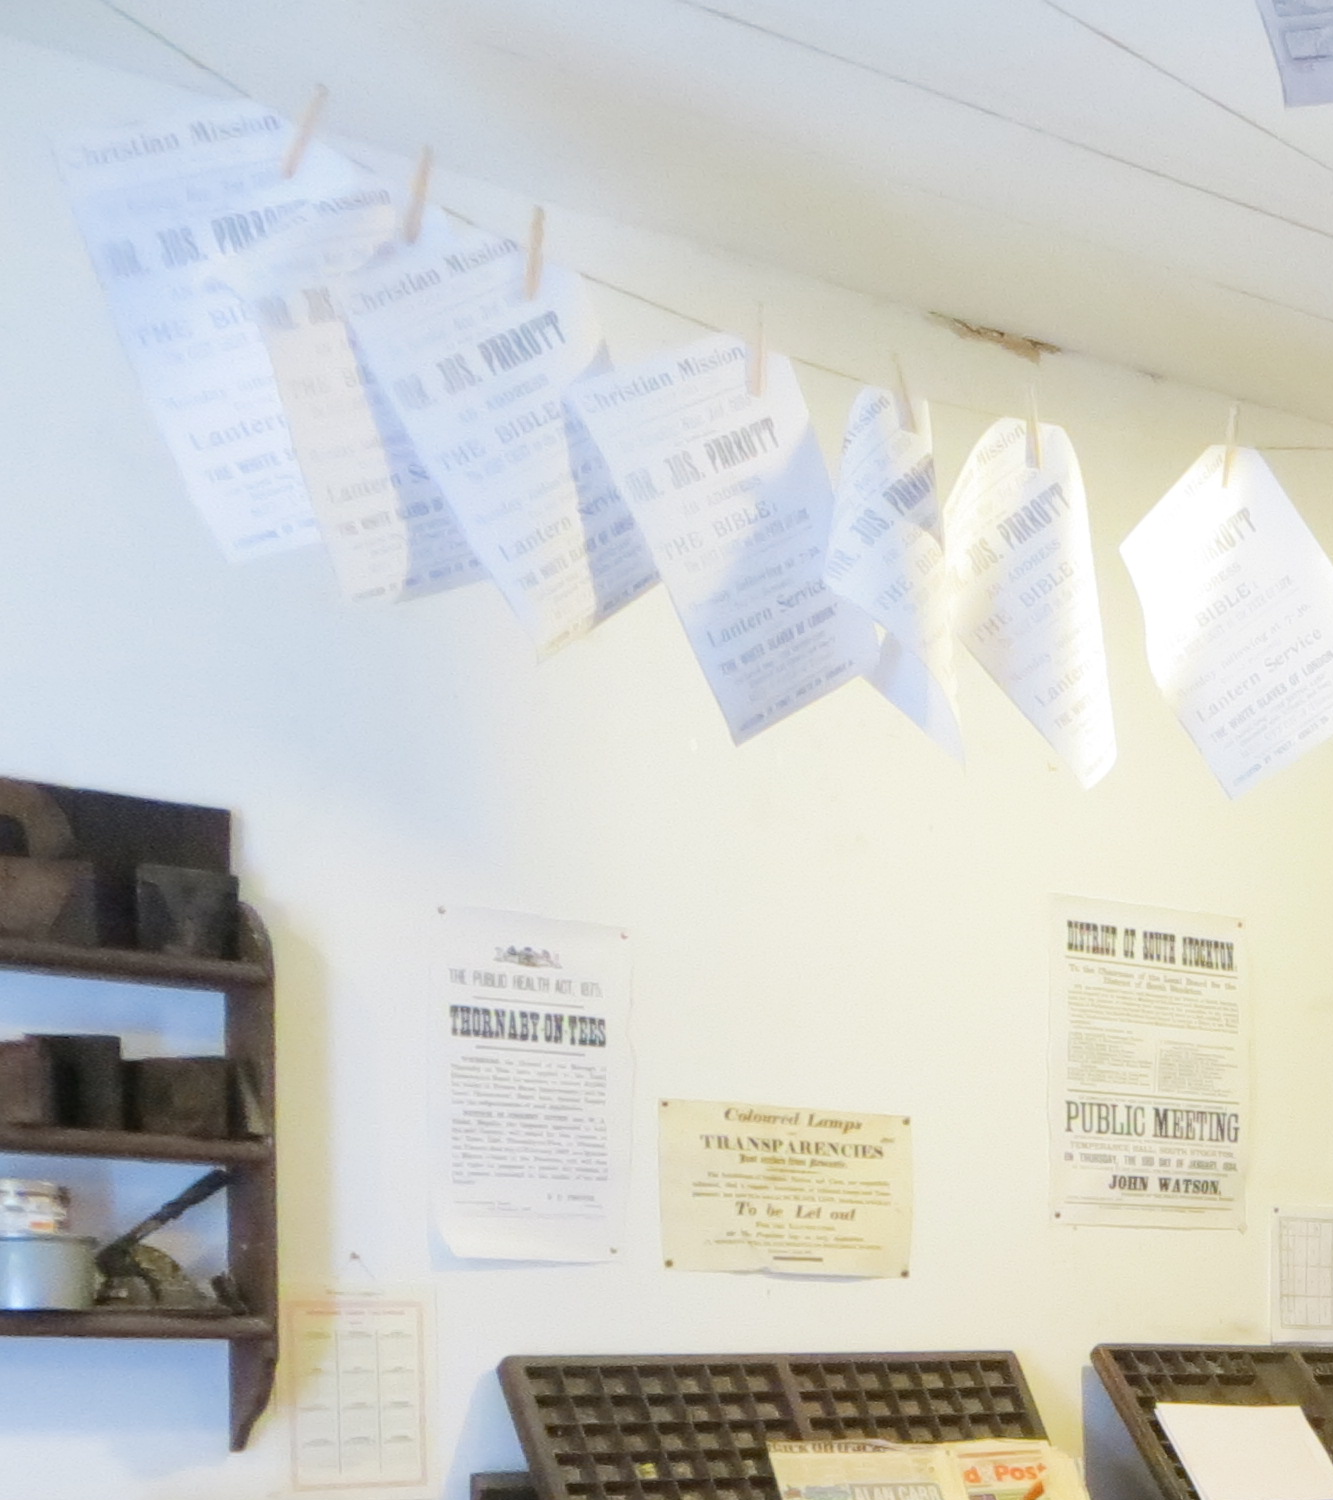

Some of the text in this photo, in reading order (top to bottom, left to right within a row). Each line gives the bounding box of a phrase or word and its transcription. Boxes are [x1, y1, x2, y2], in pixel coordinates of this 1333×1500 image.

[442, 236, 520, 275] Mission
[583, 345, 746, 415] Christian Mission
[703, 415, 779, 475] PARROTT
[996, 482, 1071, 551] PARROTT
[1195, 671, 1263, 724] Lantern
[1263, 626, 1323, 674] Service
[1067, 920, 1117, 957] DISTRICT
[1123, 928, 1136, 959] OF
[1142, 931, 1176, 964] SOUTH
[472, 970, 508, 989] PUBLIC
[512, 974, 550, 993] HEALTH
[724, 1107, 863, 1134] Coloured Lamps
[1065, 1101, 1240, 1143] PUBLIC MEETING
[699, 1134, 884, 1159] TRANSPARENCIES
[1108, 1175, 1149, 1192] JOHN
[735, 1200, 856, 1221] To be Let out
